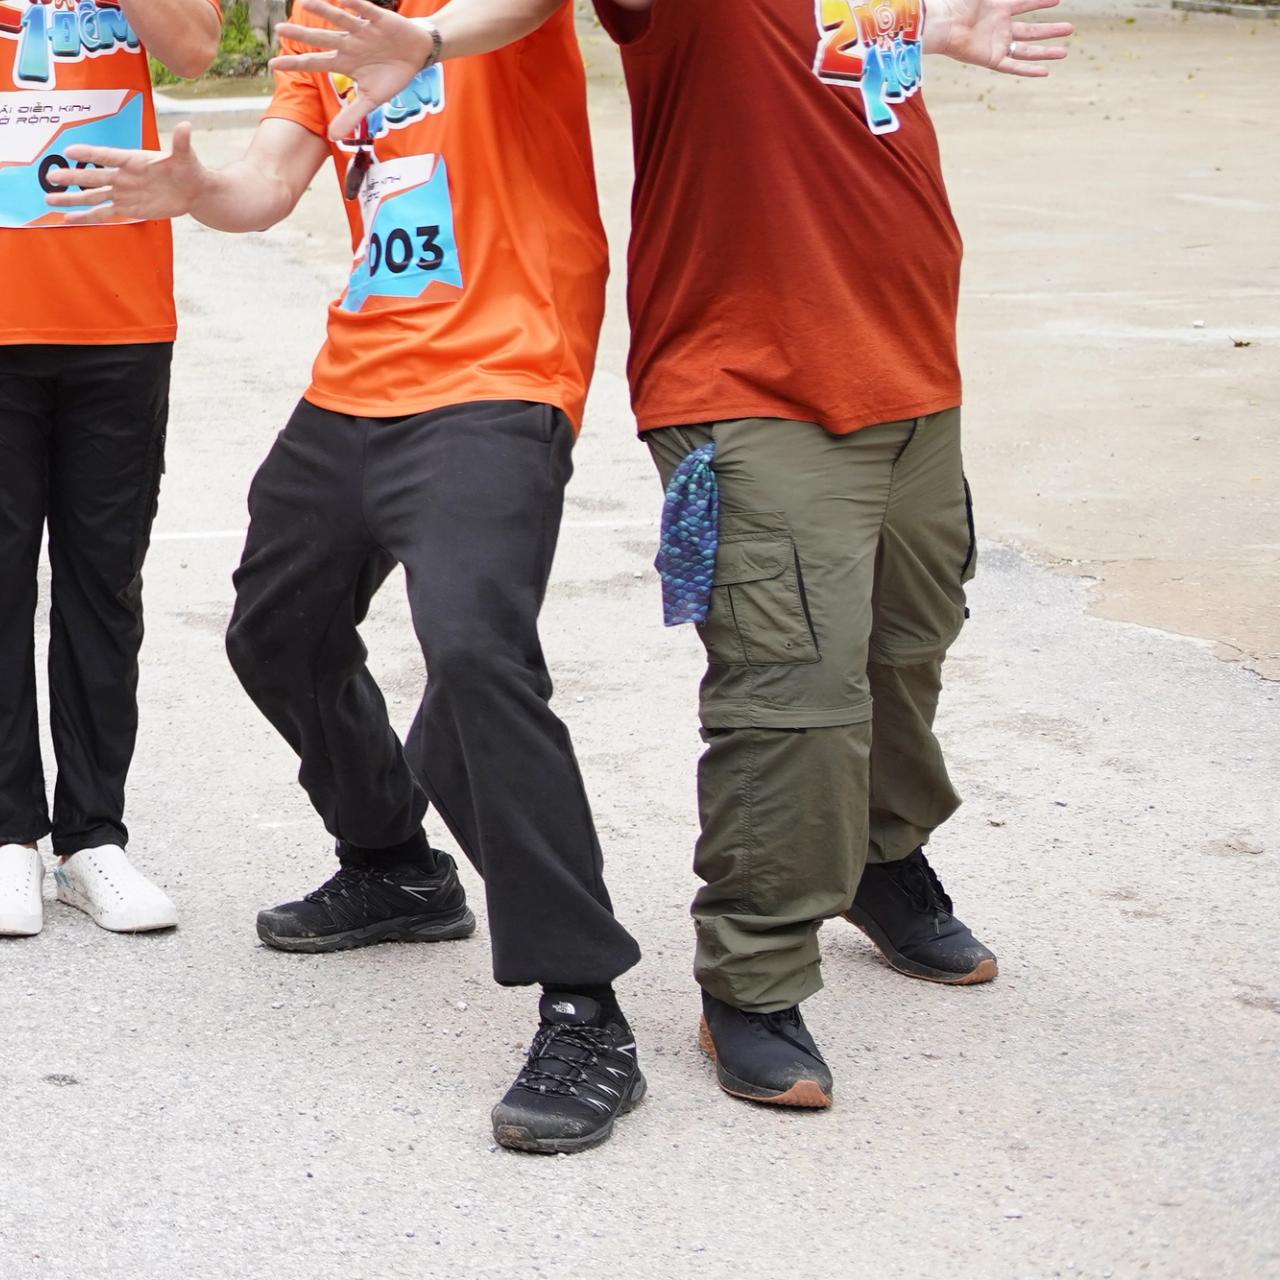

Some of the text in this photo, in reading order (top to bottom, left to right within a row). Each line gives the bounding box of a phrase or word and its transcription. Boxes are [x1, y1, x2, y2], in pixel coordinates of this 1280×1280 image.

[18, 3, 50, 83] 1
[862, 45, 893, 127] 1
[369, 224, 445, 278] 003
